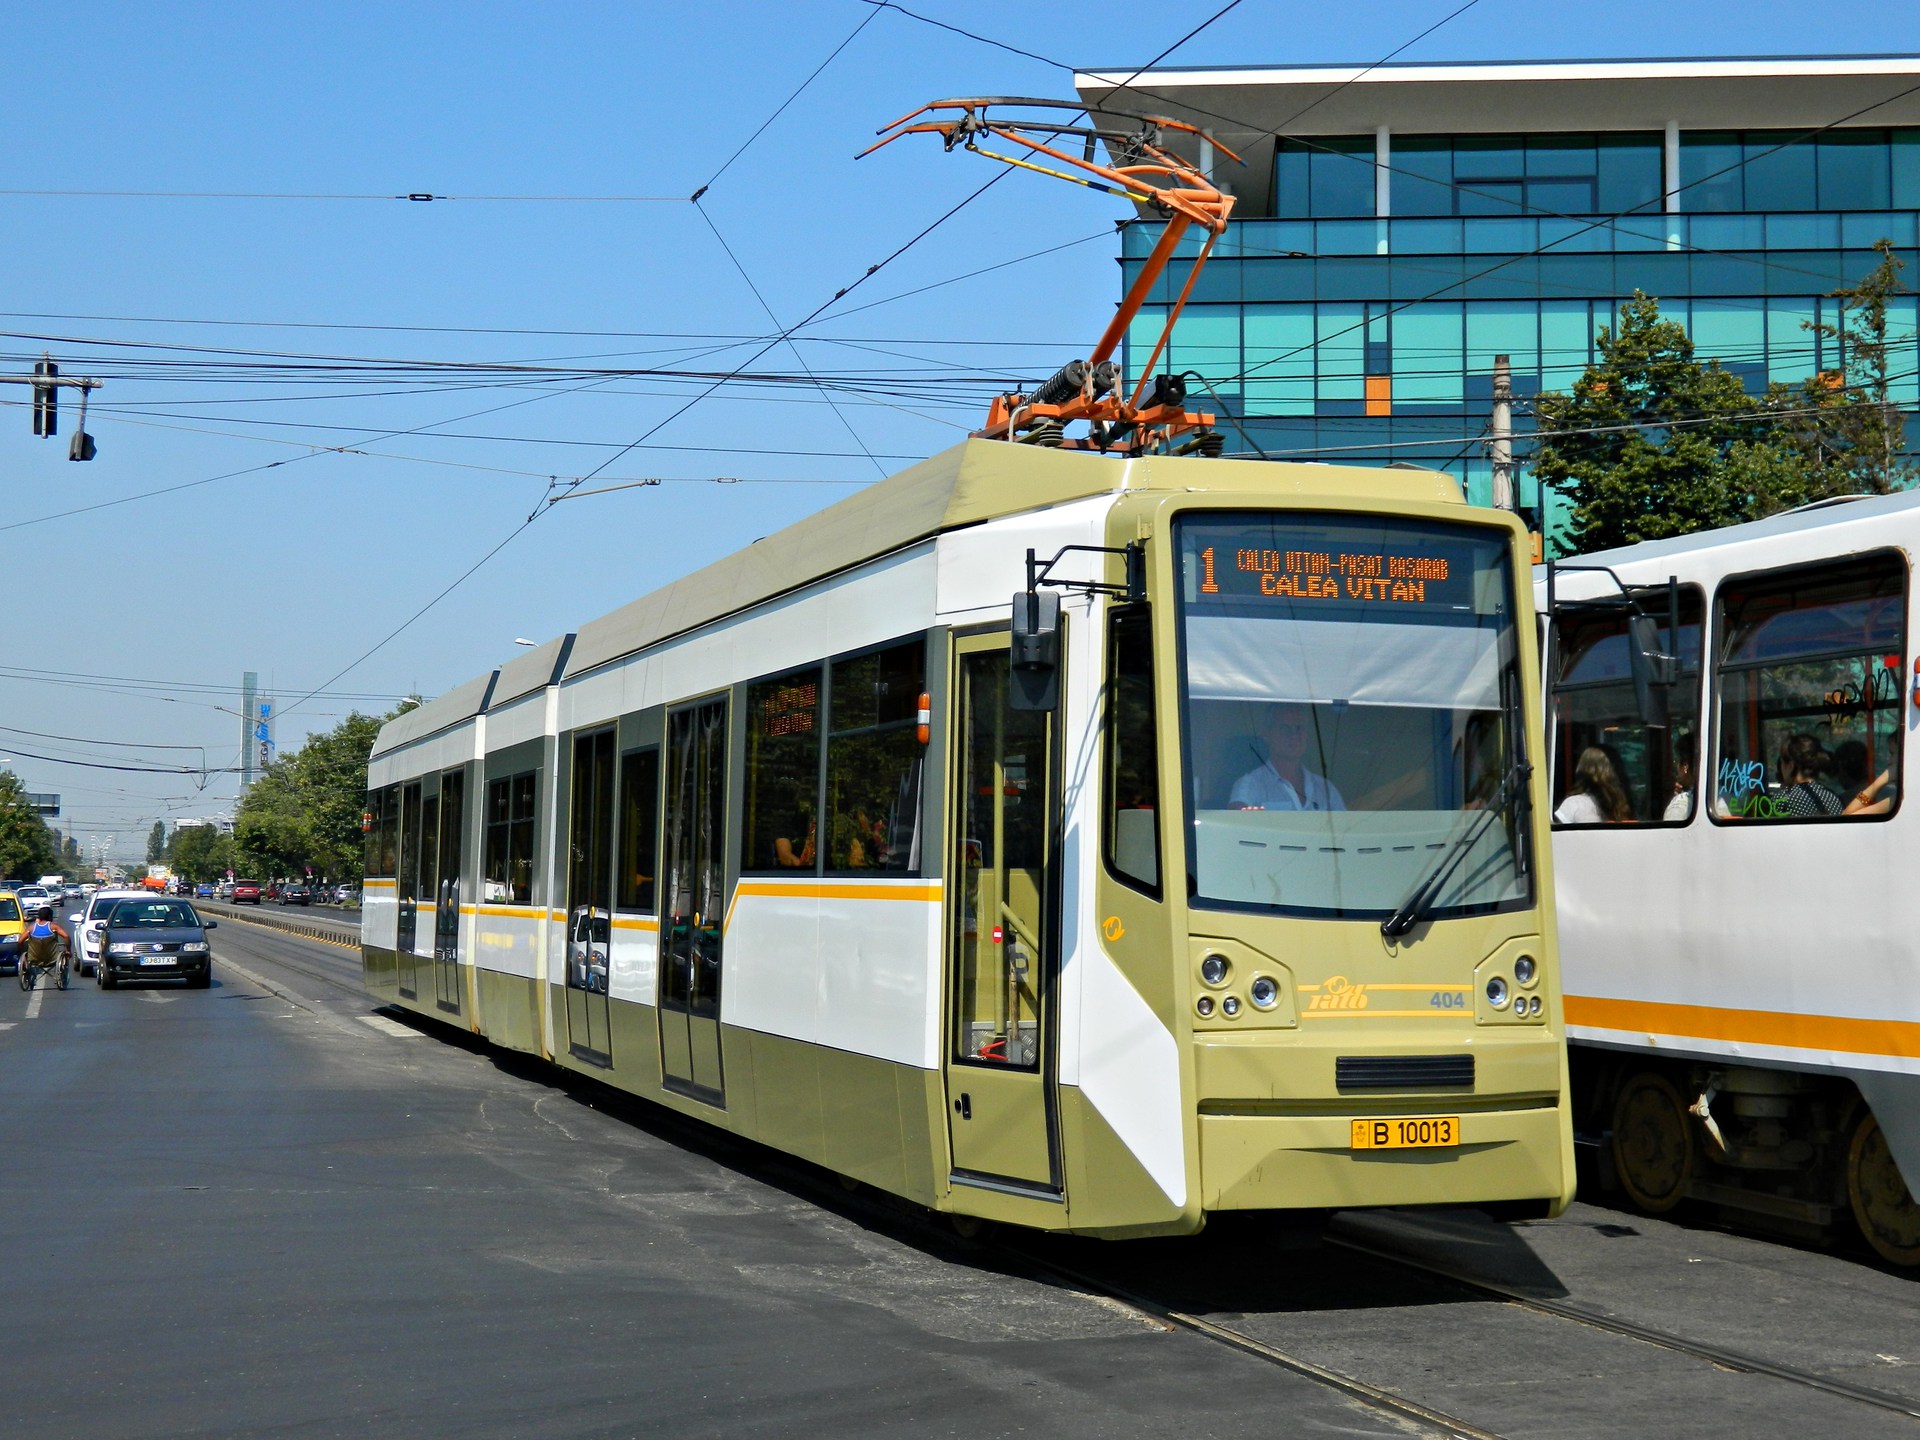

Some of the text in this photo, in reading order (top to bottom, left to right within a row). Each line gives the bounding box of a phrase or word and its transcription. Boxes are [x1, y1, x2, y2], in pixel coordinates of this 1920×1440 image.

[1201, 547, 1218, 593] 1
[1236, 548, 1280, 573] CALEA
[1388, 556, 1448, 580] BASARAB
[1261, 573, 1425, 602] CALEA VITAN
[1430, 991, 1465, 1009] 404
[1374, 1120, 1451, 1145] B 10013
